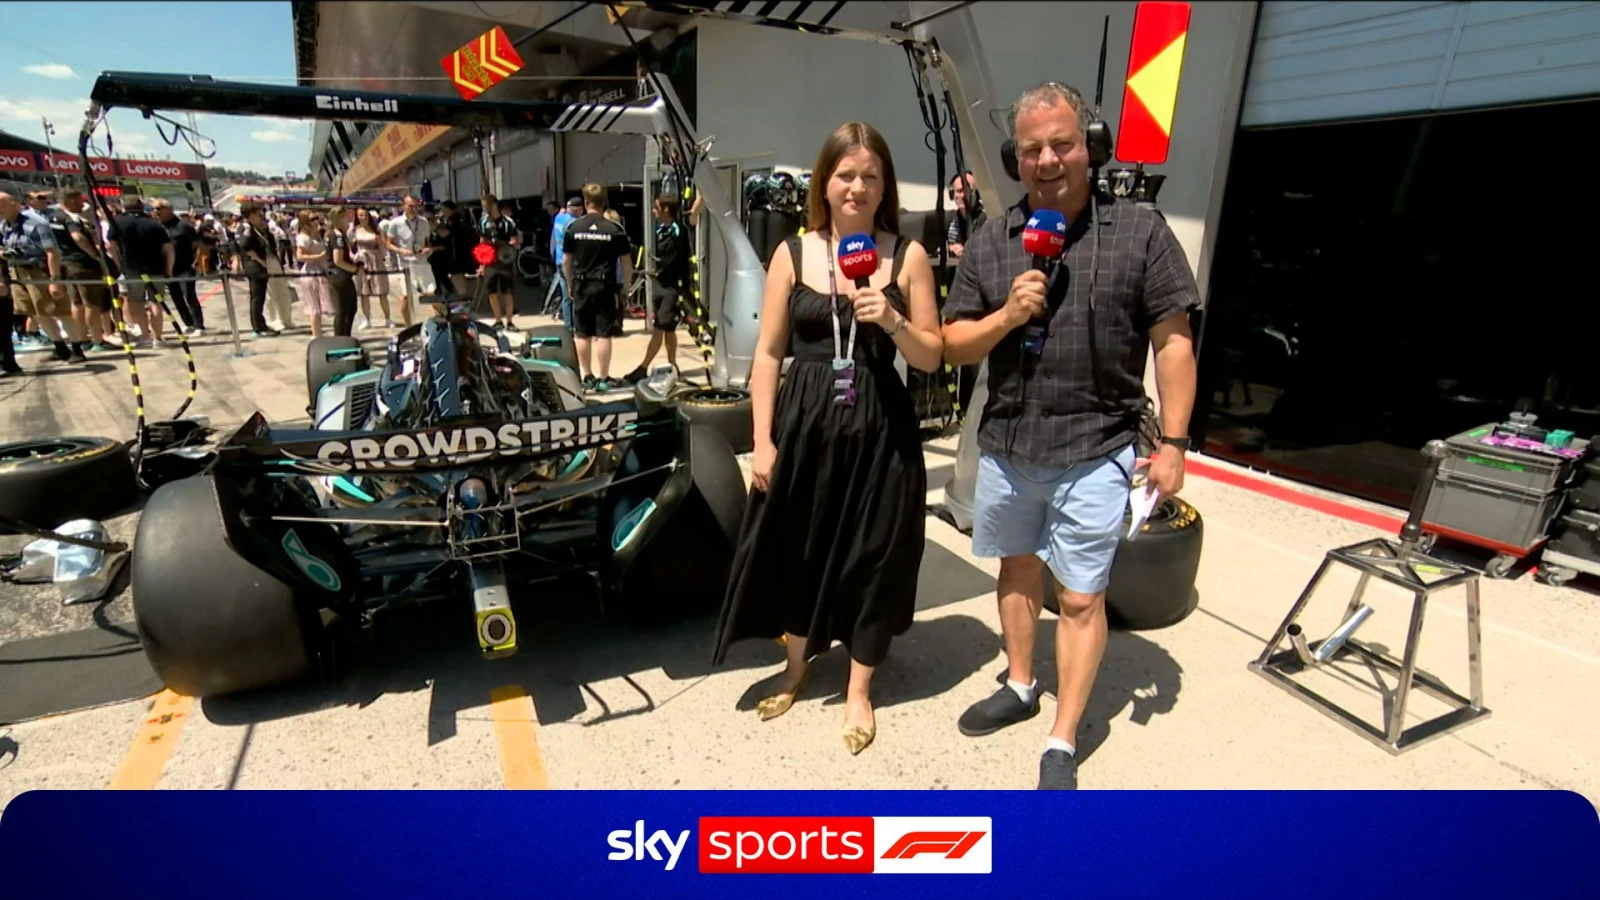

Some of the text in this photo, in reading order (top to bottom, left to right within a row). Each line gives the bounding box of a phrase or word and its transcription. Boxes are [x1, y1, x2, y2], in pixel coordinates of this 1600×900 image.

[315, 95, 399, 113] Einhell
[47, 156, 108, 172] Lenvo
[125, 163, 180, 175] Lenovo
[573, 232, 611, 241] PETRONAS
[846, 241, 865, 252] sky
[843, 253, 873, 267] sports
[317, 411, 639, 471] CROWDSTRIKE
